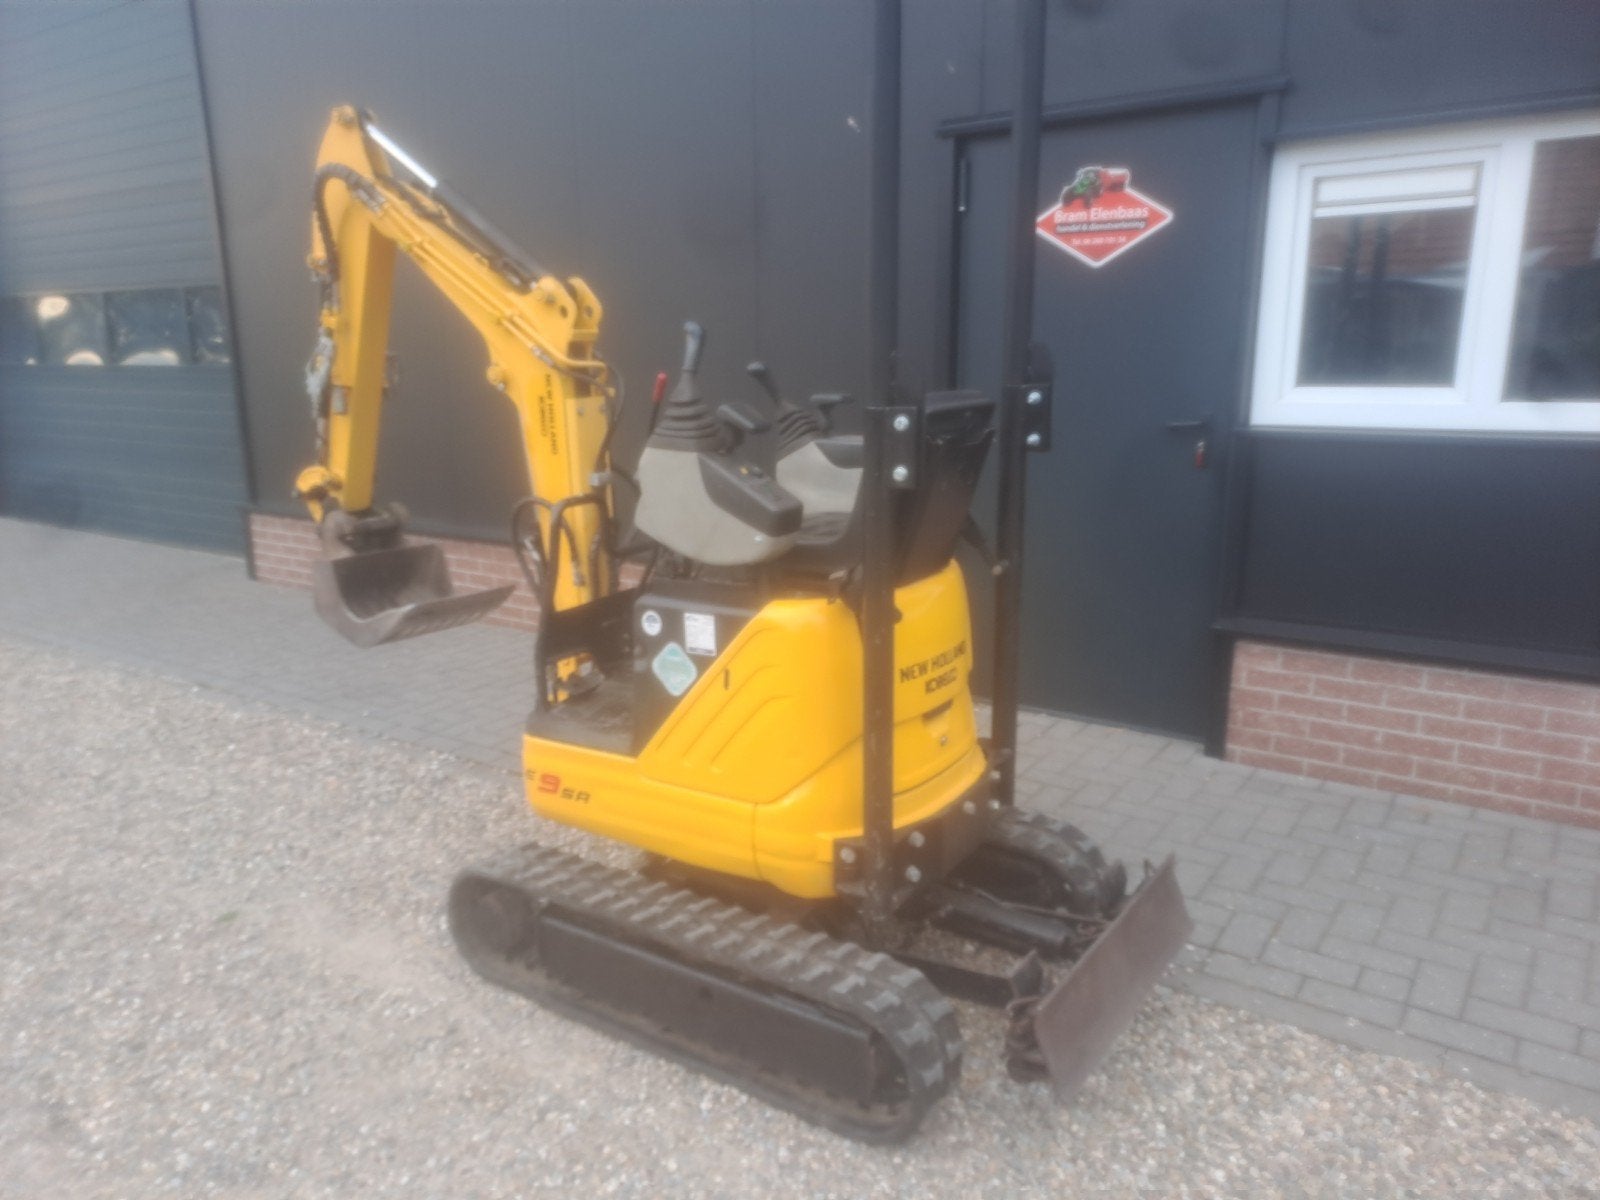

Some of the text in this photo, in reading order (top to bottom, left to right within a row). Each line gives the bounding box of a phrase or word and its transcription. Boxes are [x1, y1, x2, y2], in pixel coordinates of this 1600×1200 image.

[1054, 206, 1149, 224] Bram Elenbaas
[899, 659, 929, 684] NEW
